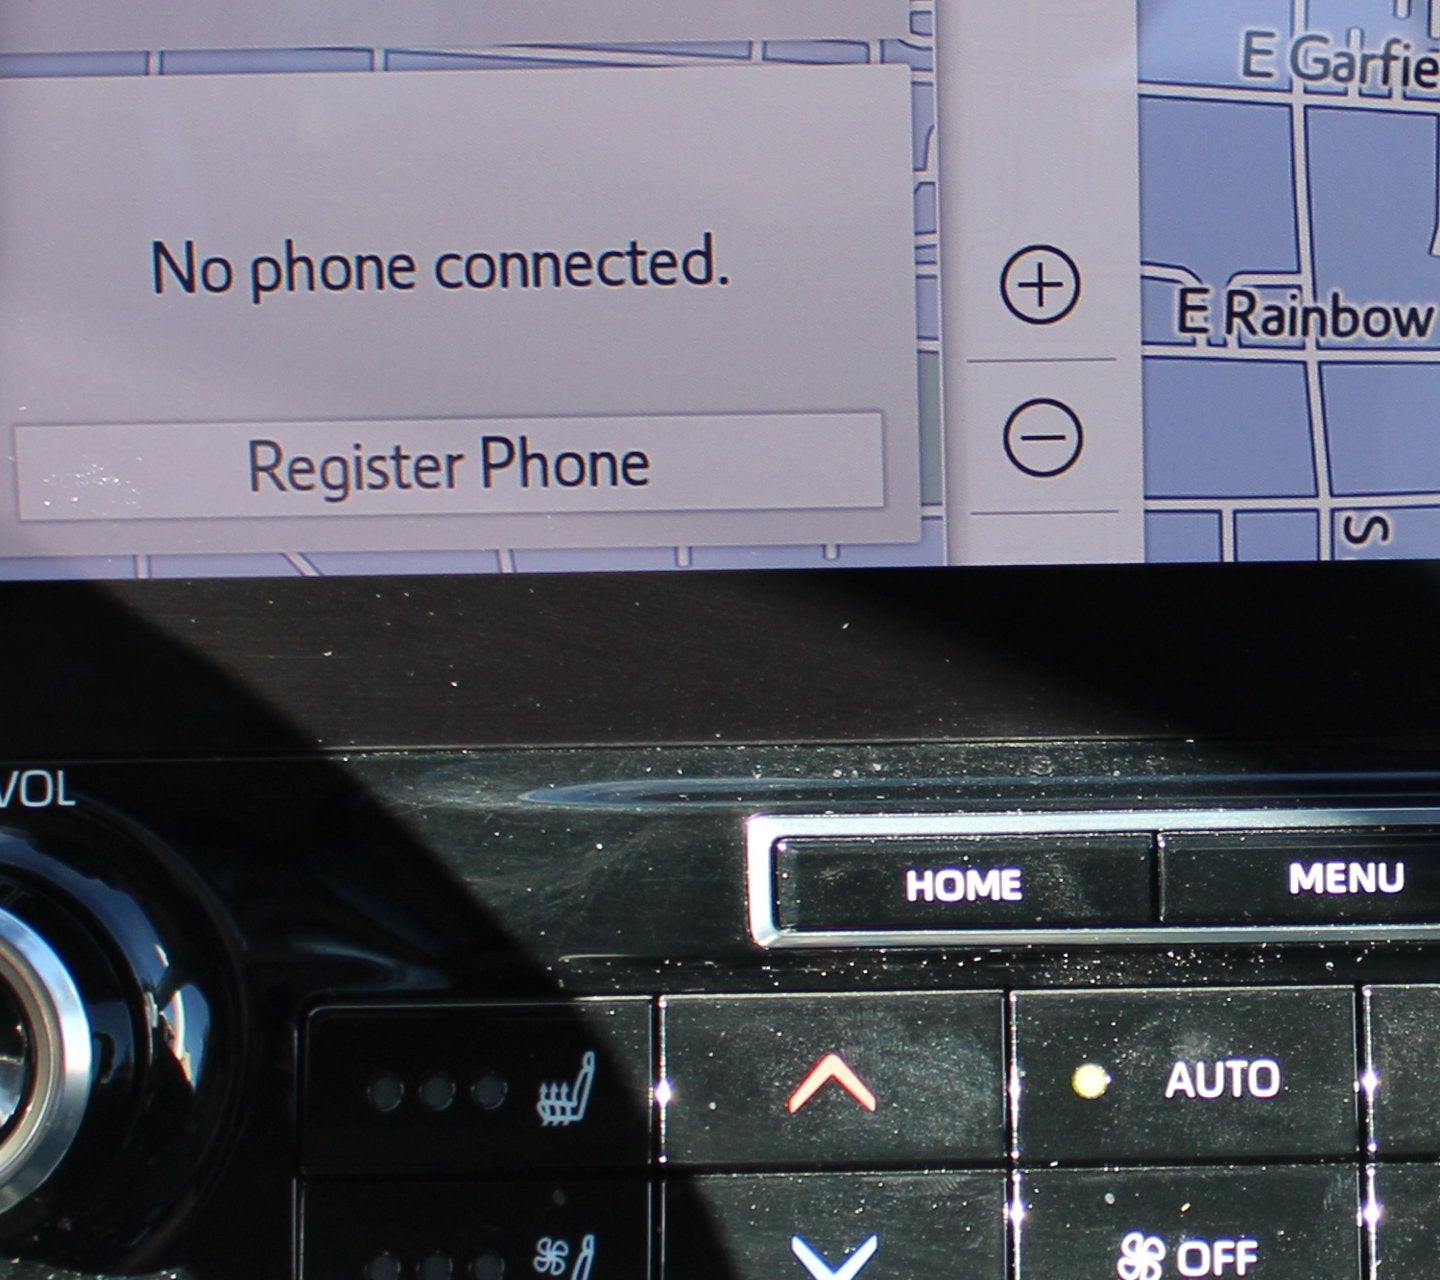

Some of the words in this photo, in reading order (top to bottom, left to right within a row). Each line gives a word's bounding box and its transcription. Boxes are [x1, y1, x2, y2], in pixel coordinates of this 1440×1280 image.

[1242, 31, 1274, 78] E
[151, 241, 233, 293] No
[252, 240, 416, 303] phone
[434, 234, 728, 288] connected.
[1179, 289, 1208, 335] E
[1228, 289, 1434, 338] Rainbow
[248, 440, 464, 502] Register
[480, 436, 649, 488] Phone
[907, 869, 1022, 903] HOME
[1289, 862, 1405, 894] MENU
[1165, 1059, 1281, 1099] AUTO
[1177, 1241, 1258, 1276] OFF
